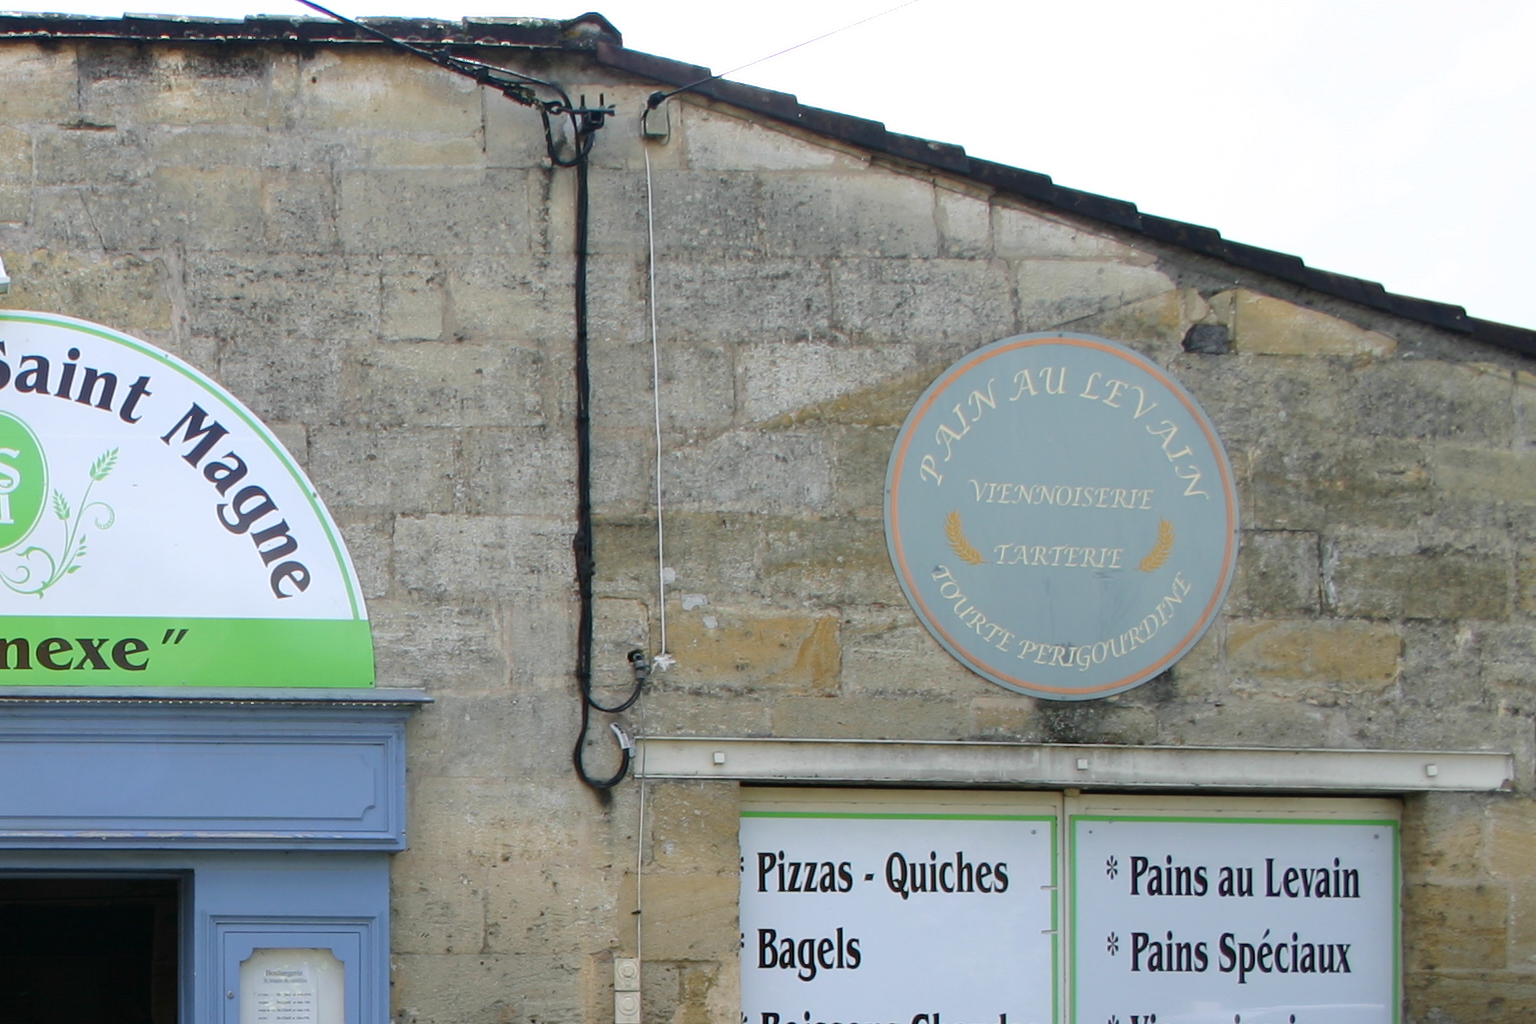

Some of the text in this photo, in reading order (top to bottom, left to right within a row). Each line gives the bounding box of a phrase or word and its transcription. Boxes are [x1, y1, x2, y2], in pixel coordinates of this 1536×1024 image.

[919, 366, 1210, 500] PAIN AU LEVAIN
[160, 402, 312, 600] Magne
[969, 479, 1154, 510] VIENNOISERIE
[993, 543, 1124, 569] TARTERIE
[931, 565, 1193, 672] TOURTE PERIGOURDINE
[756, 851, 853, 893] Pizzas
[884, 851, 1010, 900] Quiches
[1129, 855, 1361, 899] Pains au Levain
[757, 928, 862, 981] Bagels
[1130, 928, 1352, 984] Pains Spéciaux
